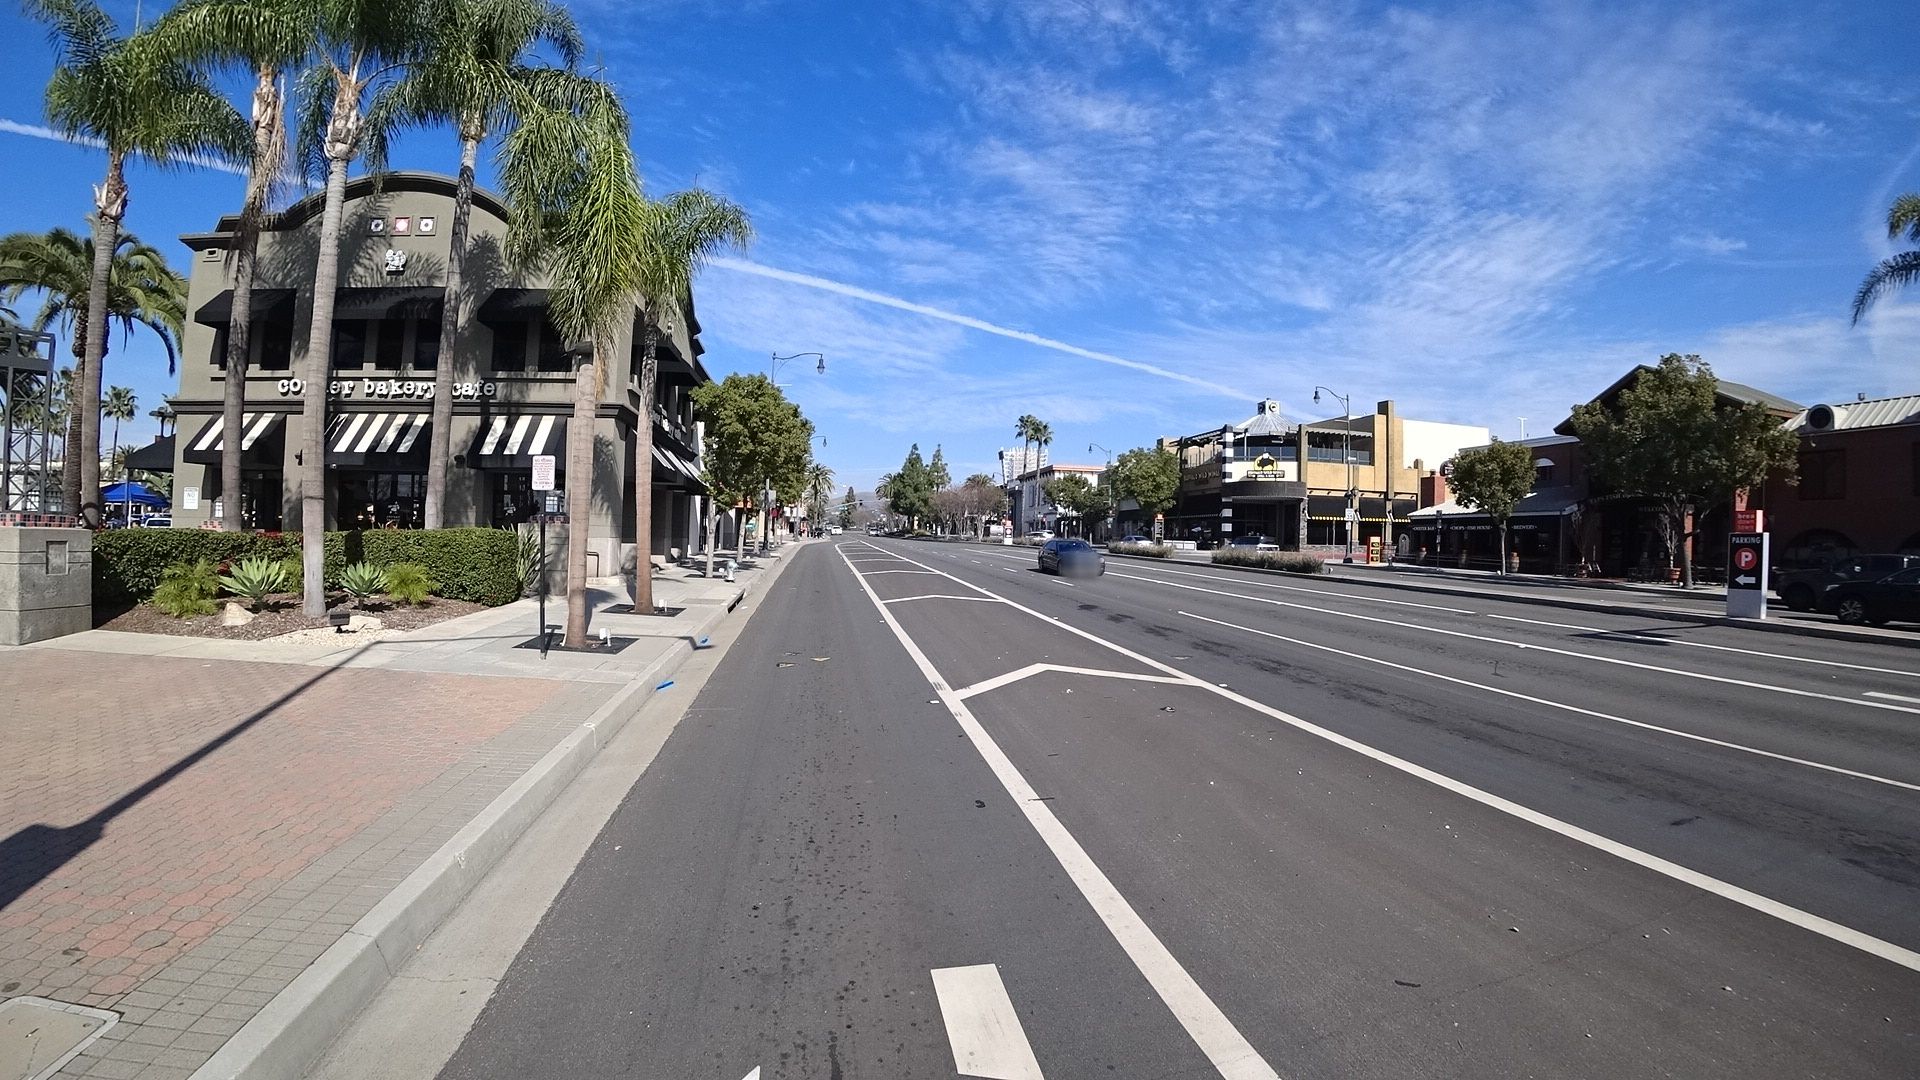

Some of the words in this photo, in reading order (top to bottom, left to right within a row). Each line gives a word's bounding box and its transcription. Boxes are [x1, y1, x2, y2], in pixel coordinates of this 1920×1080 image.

[278, 379, 354, 394] coer
[363, 378, 437, 398] bakery
[452, 380, 496, 396] cafe
[1731, 536, 1761, 544] PARKING
[1741, 551, 1752, 567] P
